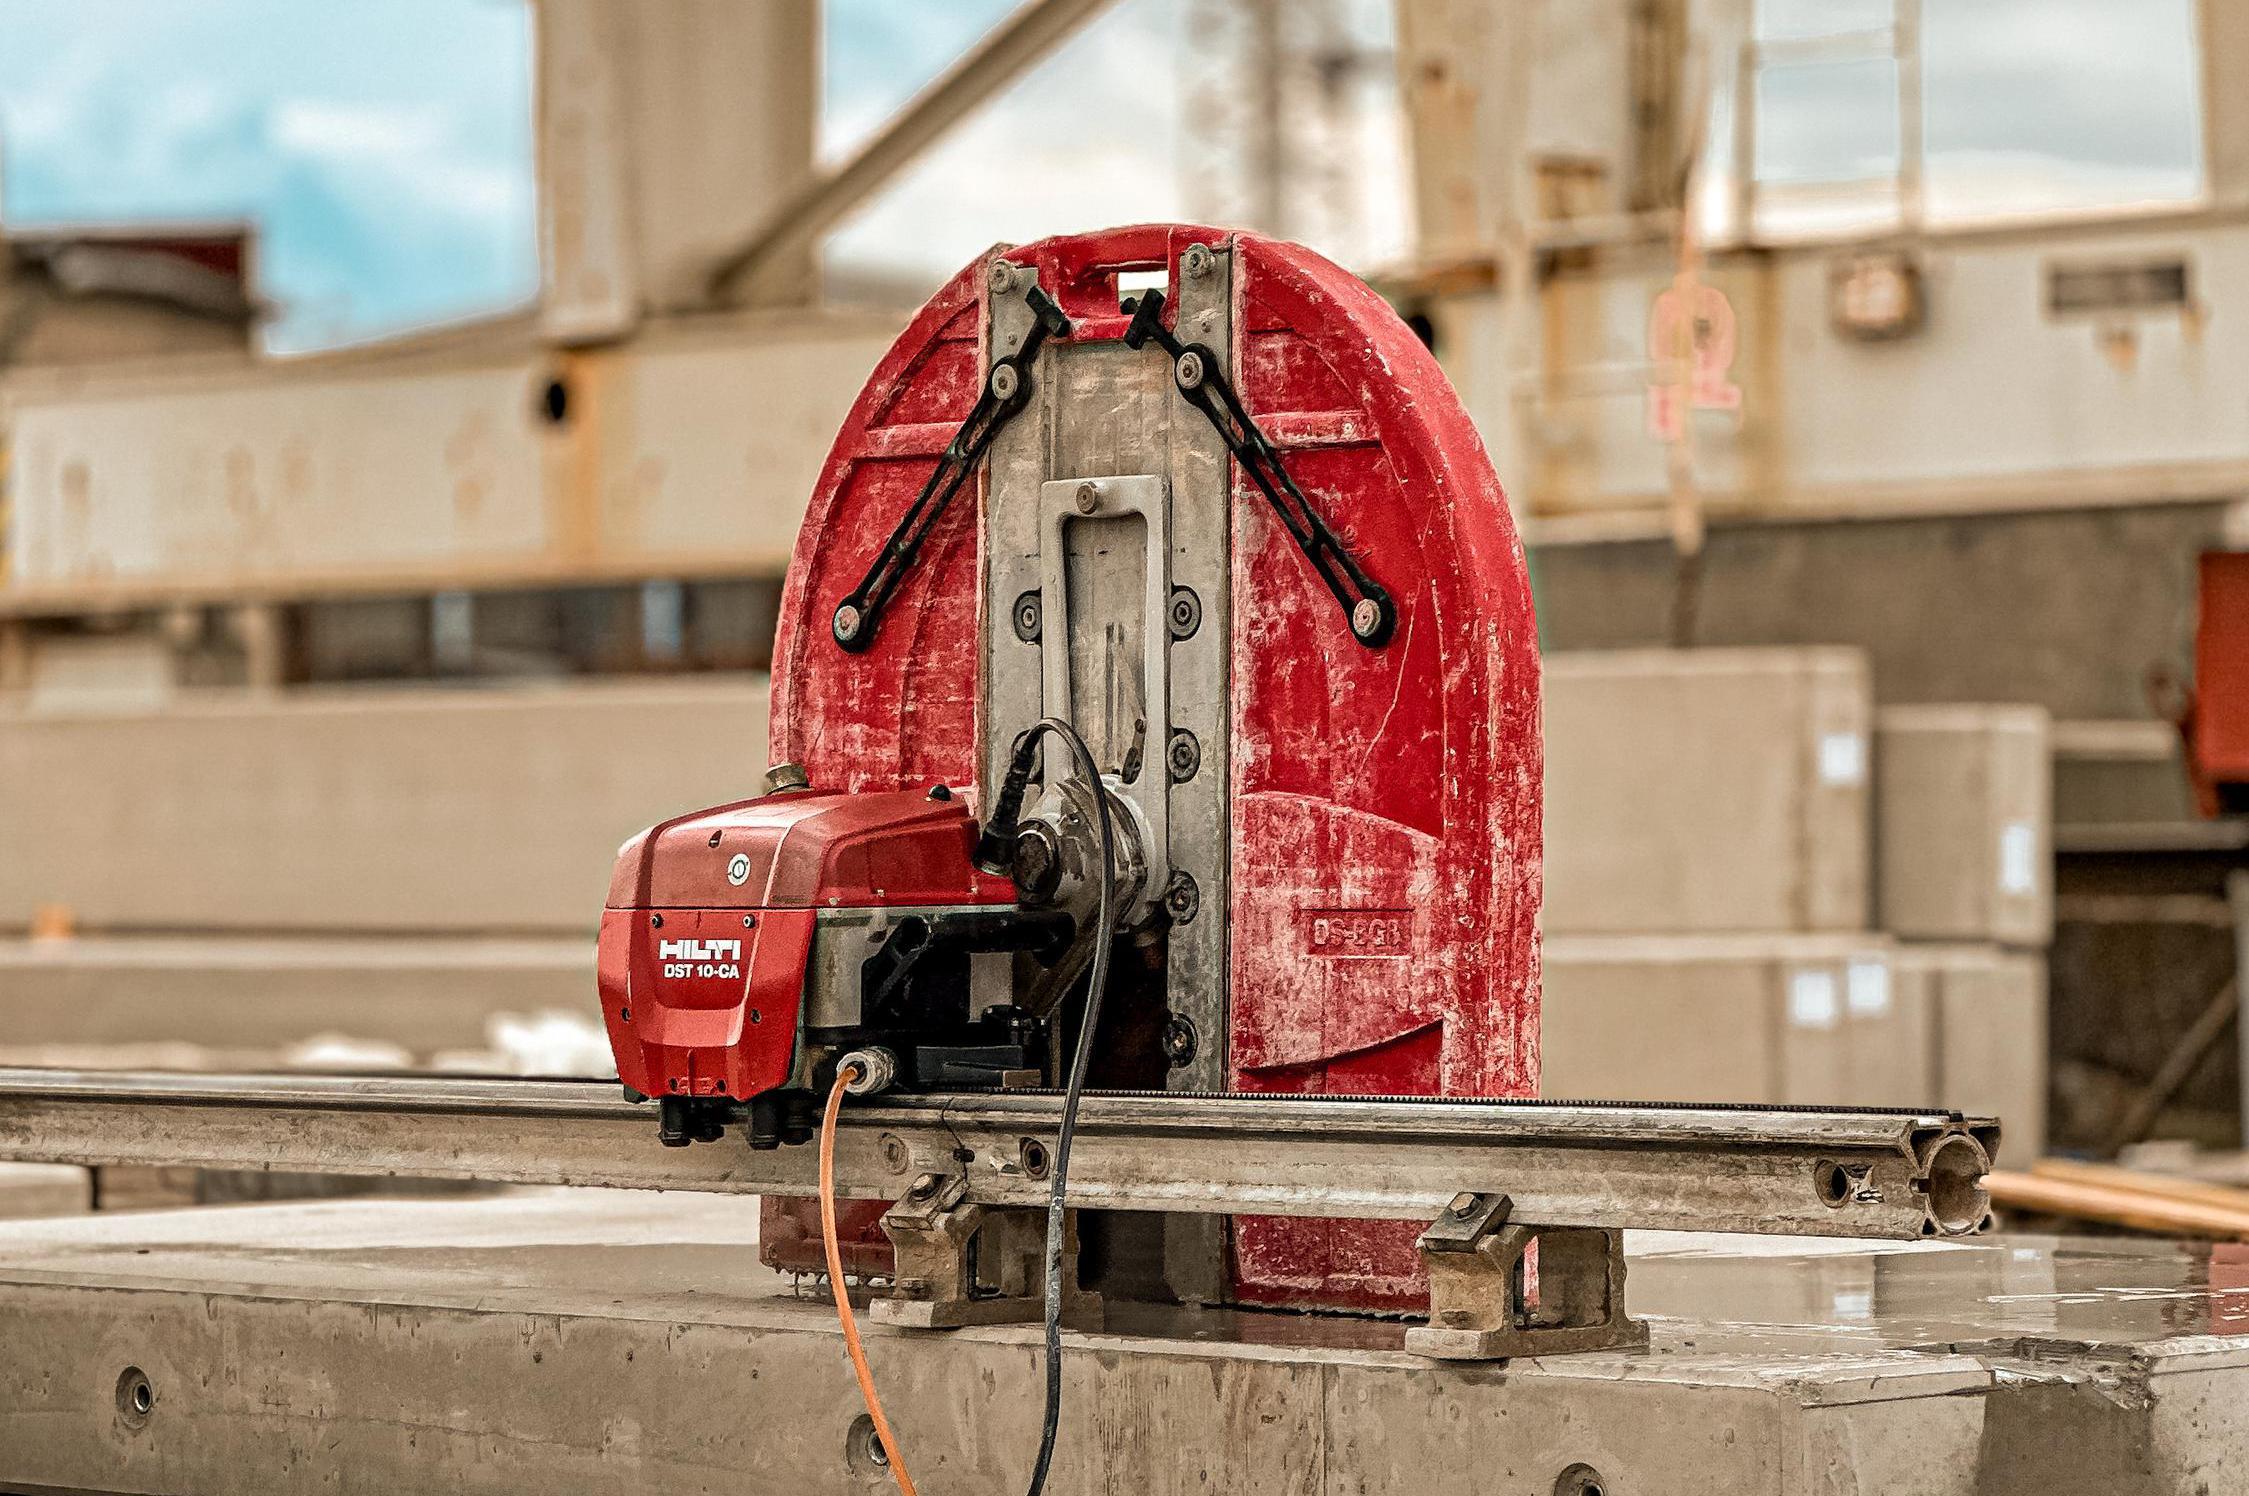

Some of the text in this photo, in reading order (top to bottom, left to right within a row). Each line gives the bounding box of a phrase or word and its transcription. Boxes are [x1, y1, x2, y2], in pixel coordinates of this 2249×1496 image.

[659, 939, 742, 960] HILTI
[664, 964, 740, 979] DST 10-CA
